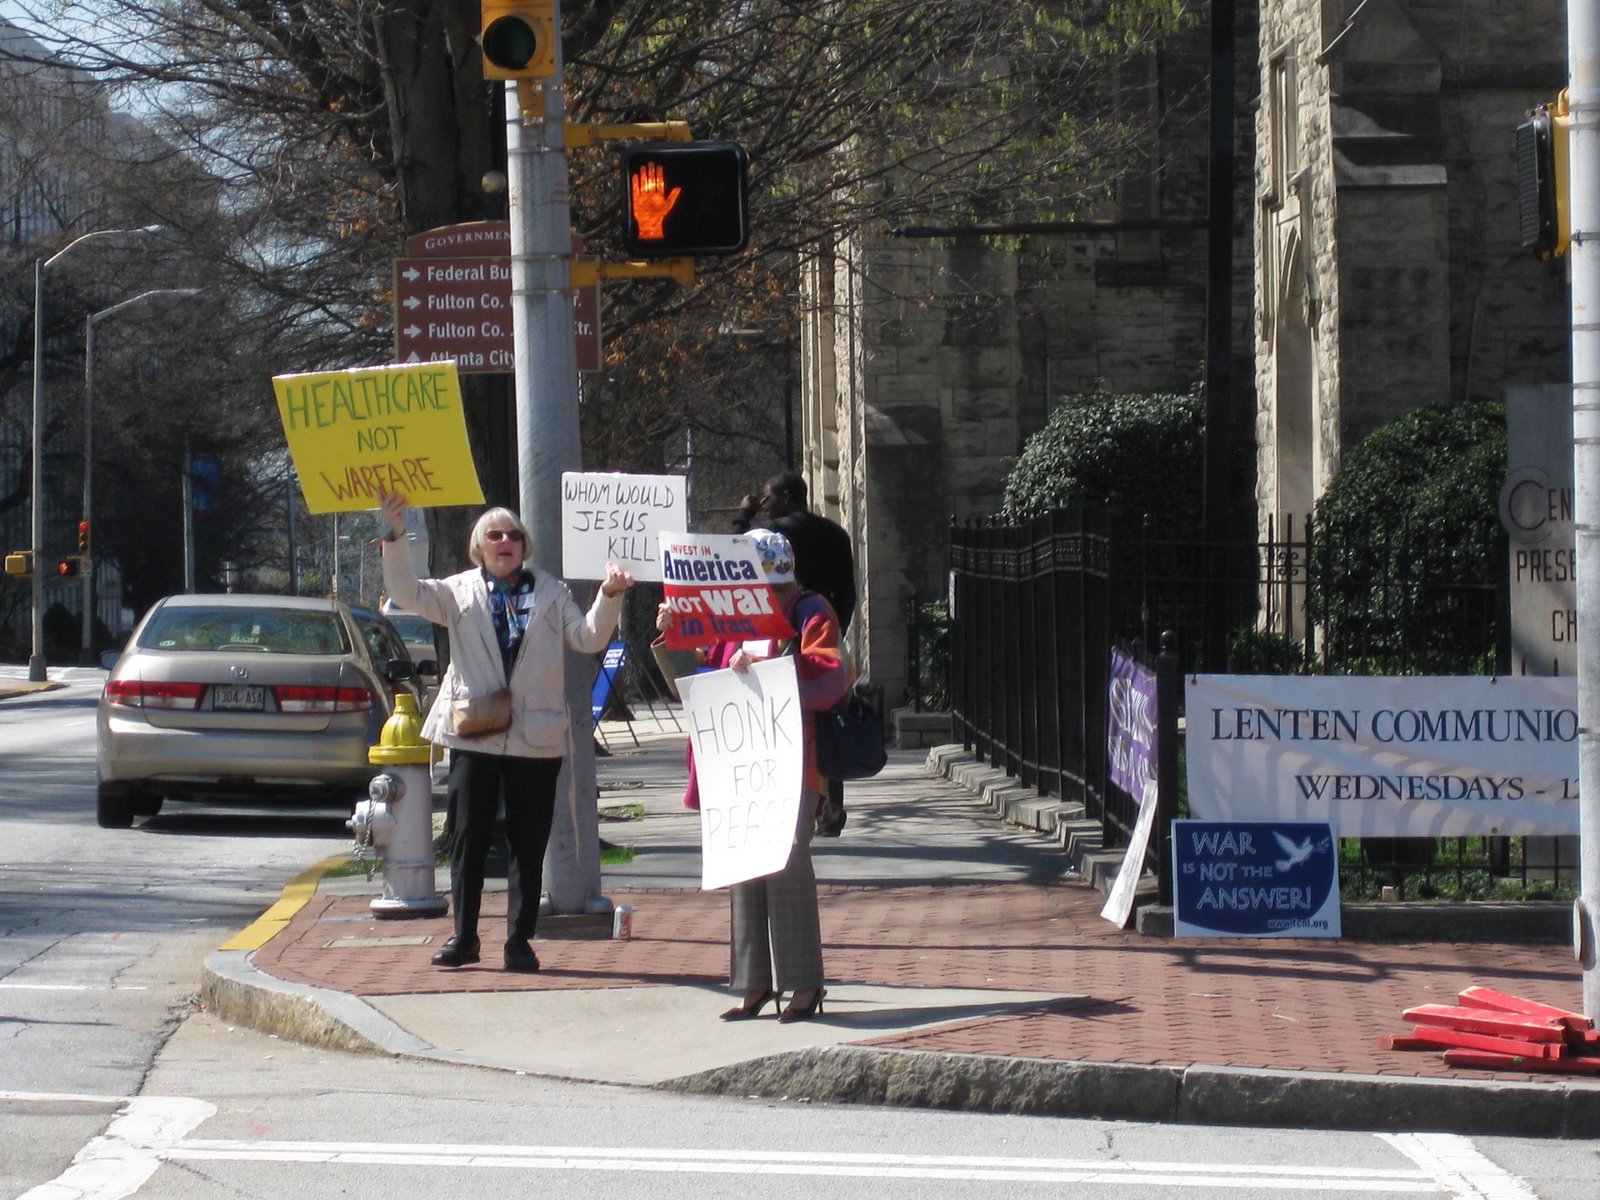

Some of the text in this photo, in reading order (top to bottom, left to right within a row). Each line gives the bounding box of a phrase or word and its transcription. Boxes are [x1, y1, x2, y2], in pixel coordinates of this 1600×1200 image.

[427, 264, 484, 282] Federal
[428, 294, 474, 310] Fulton
[480, 293, 504, 309] Co.
[428, 322, 475, 338] Fulton
[481, 322, 505, 337] Co.
[574, 322, 593, 335] tr.
[286, 372, 450, 430] HEALTHCARE
[357, 426, 404, 452] NOT
[319, 458, 442, 501] WARFARE
[564, 480, 674, 508] WHOM WOULD
[1509, 480, 1575, 530] CEN
[572, 510, 648, 532] JESUS
[608, 537, 660, 561] KILL
[671, 544, 711, 556] INVEST IN
[664, 550, 758, 581] America
[665, 596, 703, 613] NOT
[680, 614, 758, 637] in Iraq
[692, 697, 794, 754] HONK
[1211, 707, 1360, 742] LENTEN
[733, 759, 777, 795] FOR
[1294, 774, 1524, 801] WEDNESDAYS
[1192, 831, 1256, 857] WAR
[1182, 862, 1274, 882] IS NOT THE
[1196, 886, 1312, 911] ANSWER!
